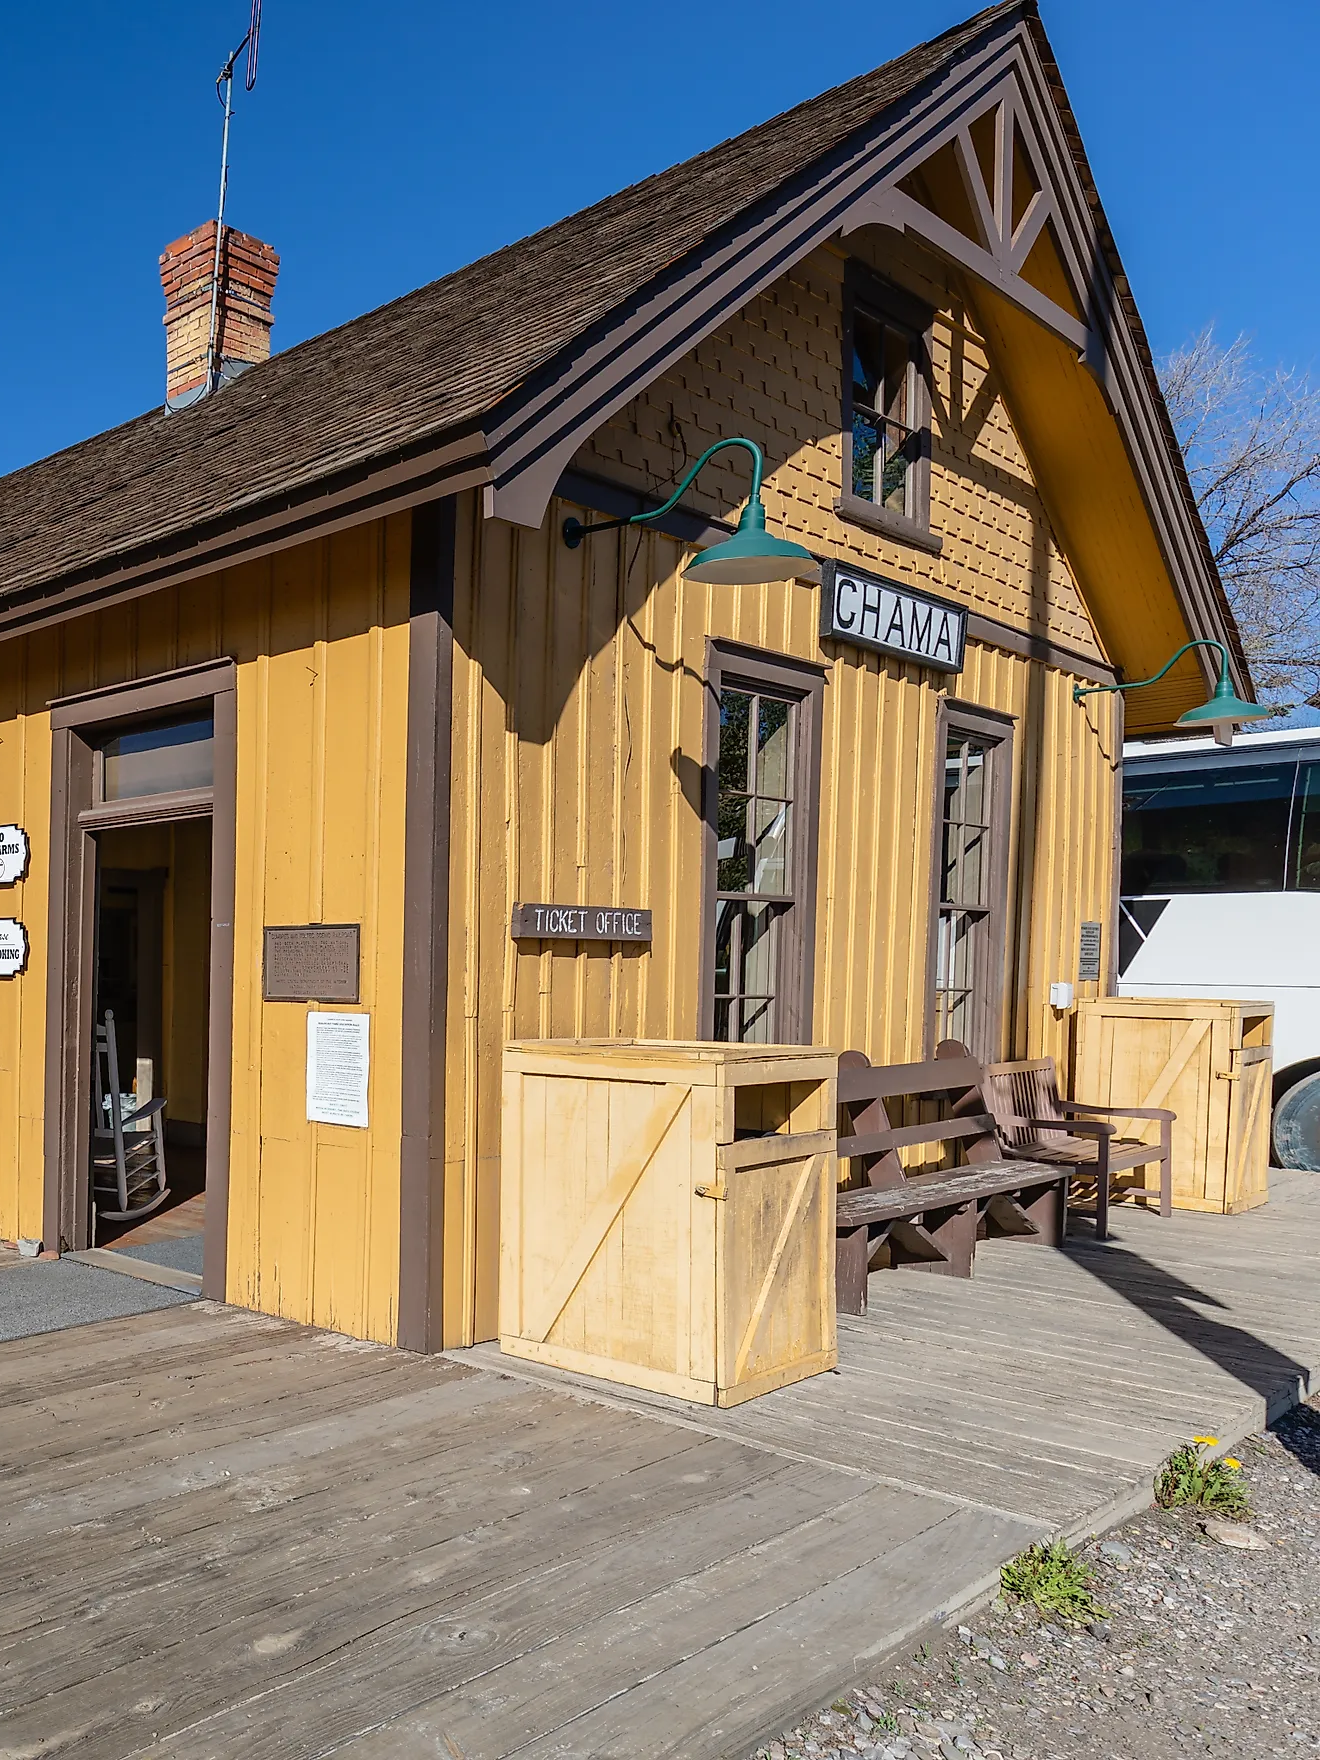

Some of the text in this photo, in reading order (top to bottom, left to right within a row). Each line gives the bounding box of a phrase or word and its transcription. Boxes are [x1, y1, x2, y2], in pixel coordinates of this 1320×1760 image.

[836, 578, 953, 661] CHAMA
[534, 908, 642, 935] TICKET OFFICE
